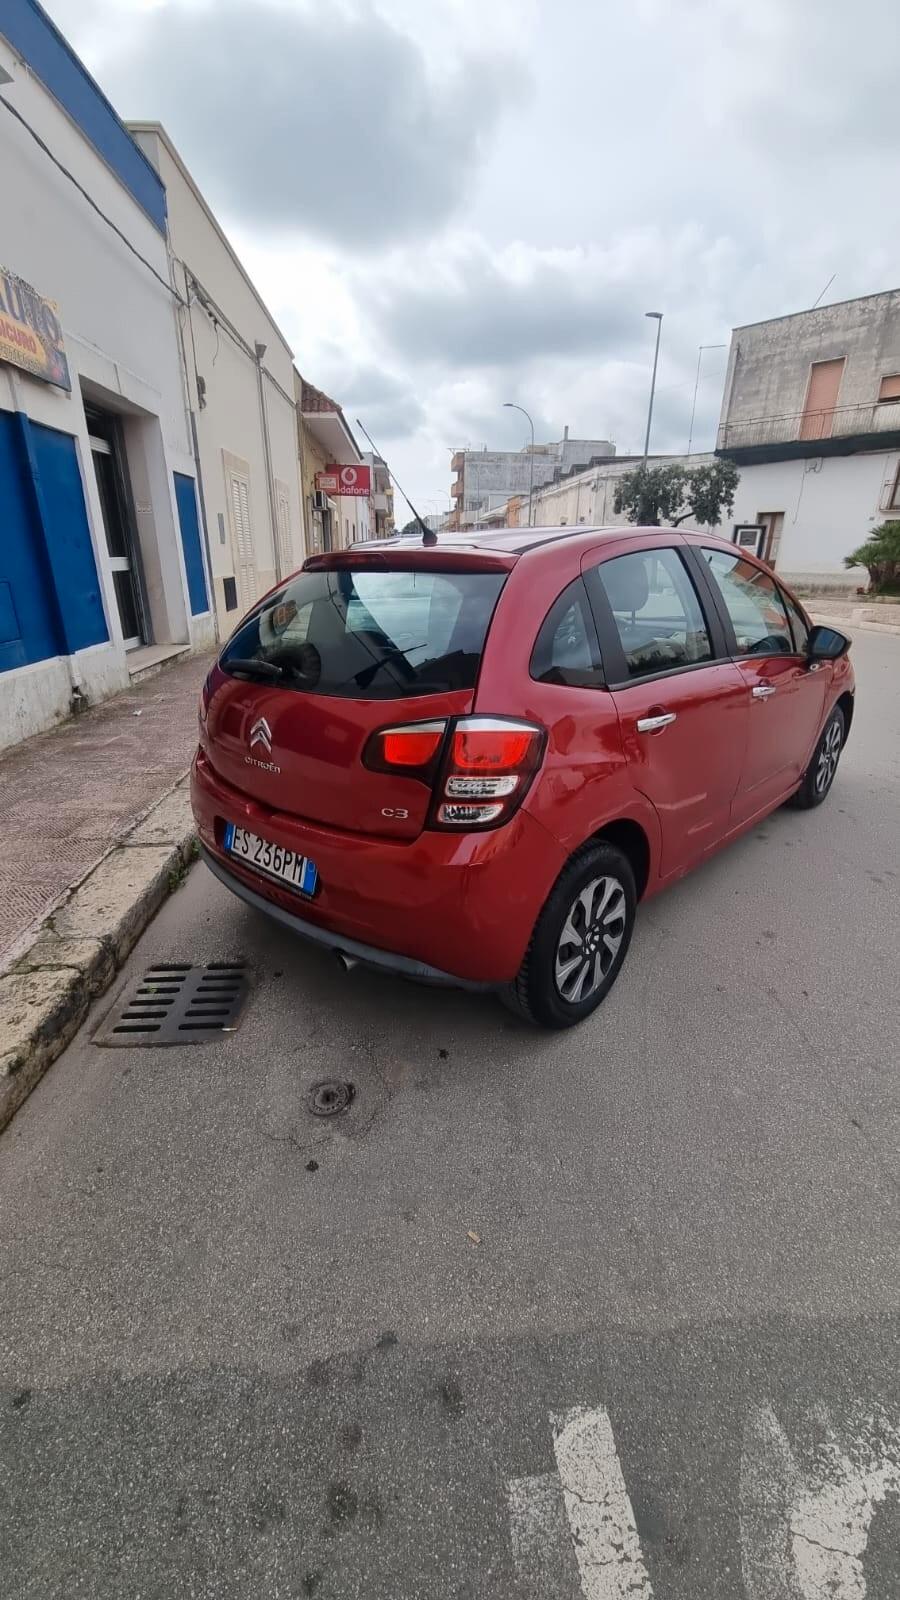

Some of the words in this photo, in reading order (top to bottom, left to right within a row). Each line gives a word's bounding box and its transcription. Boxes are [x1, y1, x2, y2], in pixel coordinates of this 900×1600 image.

[339, 485, 370, 495] dafone
[381, 807, 409, 819] C3
[232, 826, 251, 854] ES
[253, 837, 304, 884] 236PM
